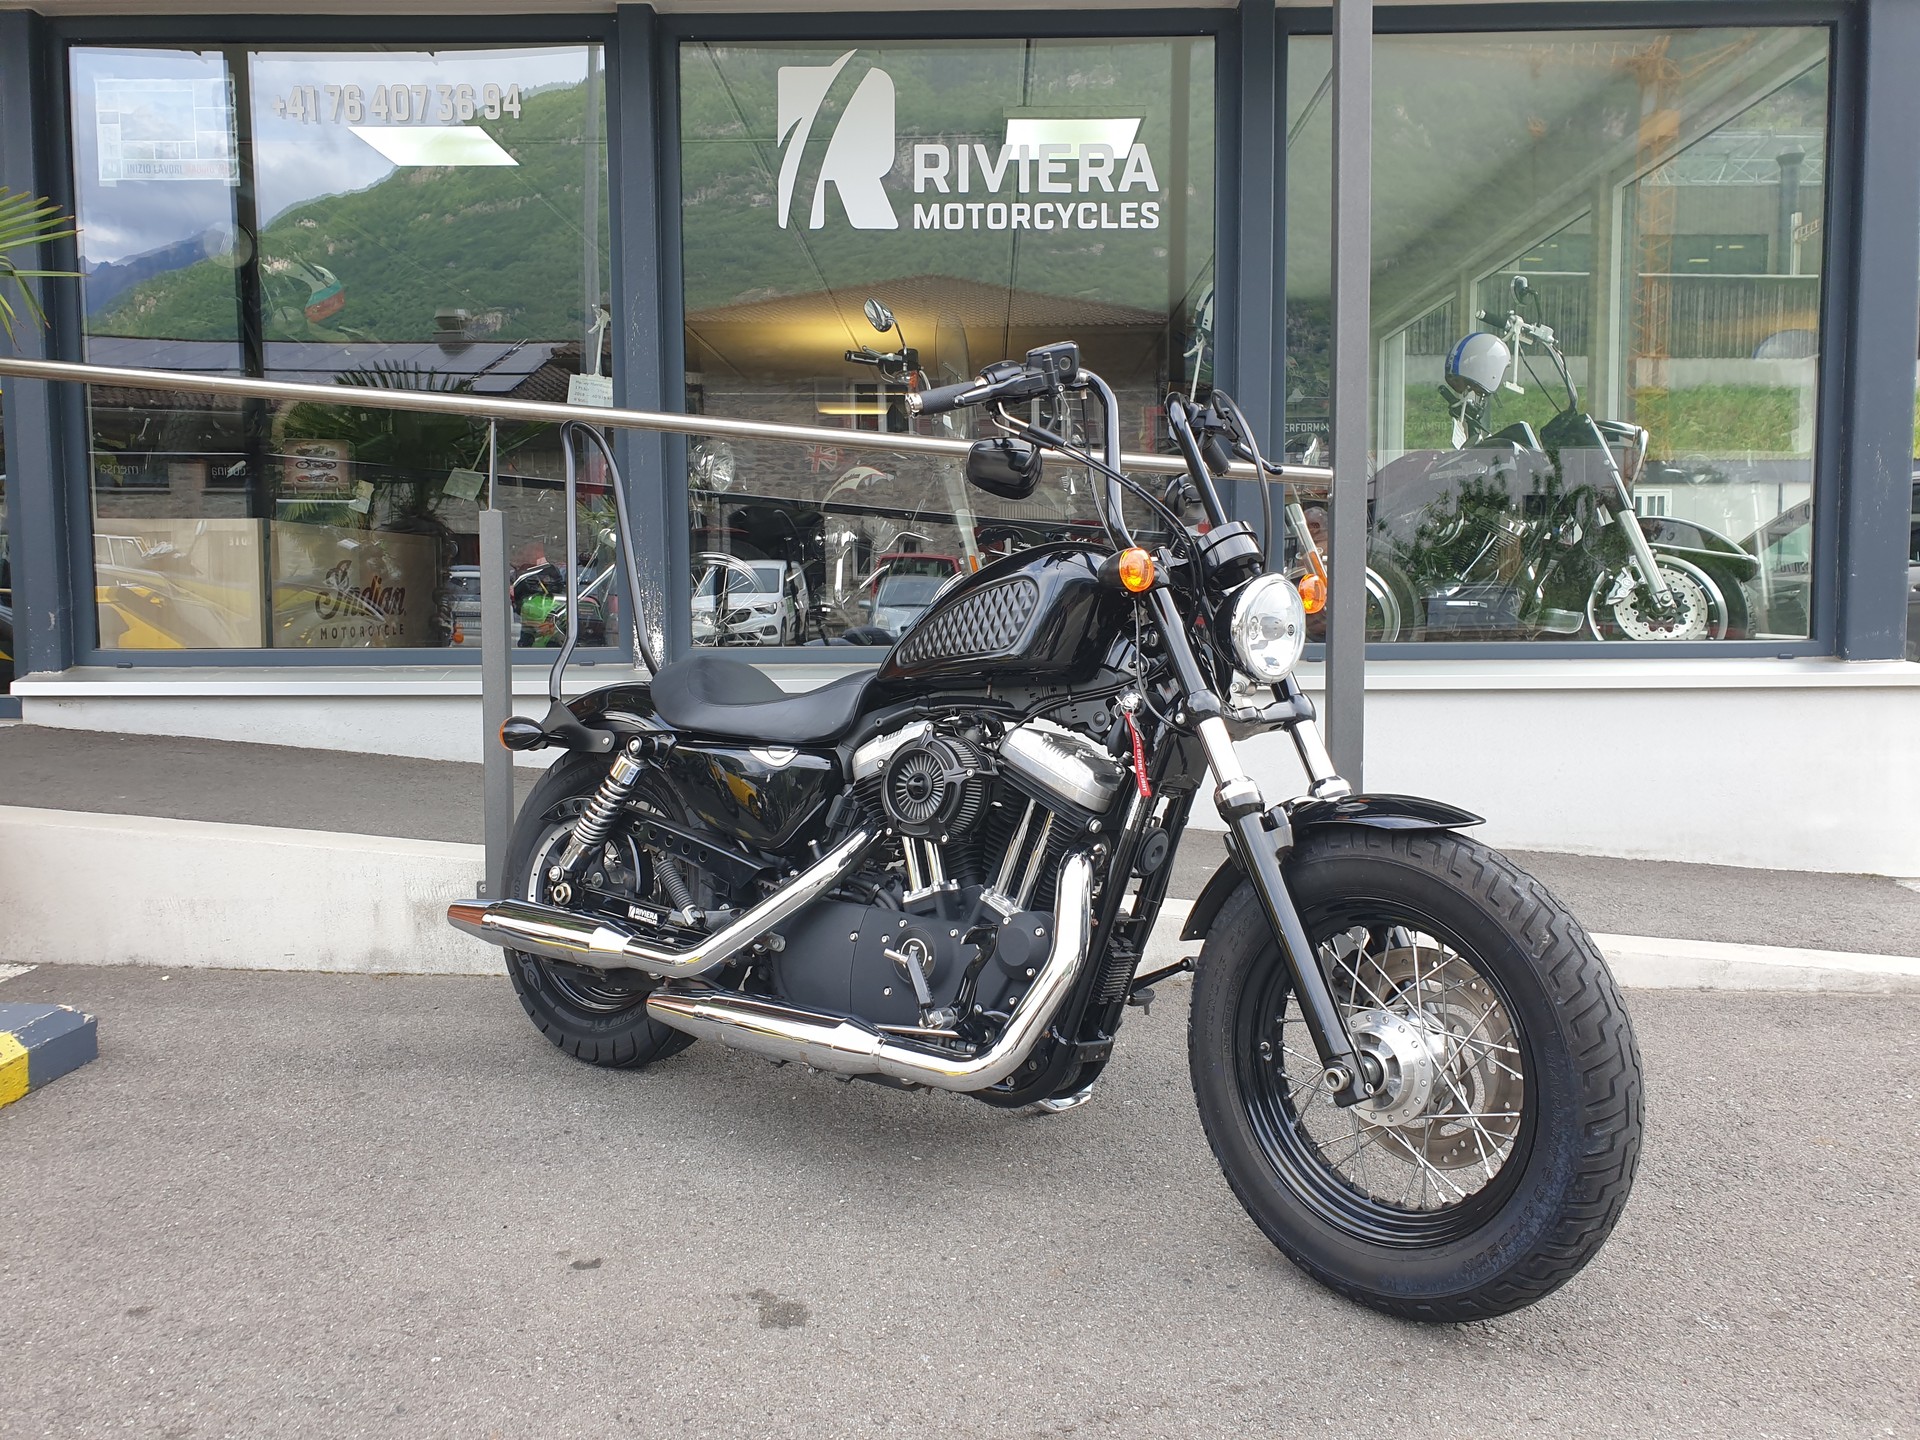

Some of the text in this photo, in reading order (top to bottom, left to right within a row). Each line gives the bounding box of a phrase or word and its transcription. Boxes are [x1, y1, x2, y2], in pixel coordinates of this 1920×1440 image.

[273, 83, 523, 122] +41 76 407 36 94
[127, 163, 152, 175] INIZIO
[154, 163, 183, 176] LAVORI
[914, 143, 1160, 193] RIVIERA
[914, 202, 1160, 230] MOTORCYCLES
[320, 623, 405, 640] MOTORCYCLE
[635, 907, 658, 920] RIVIERA
